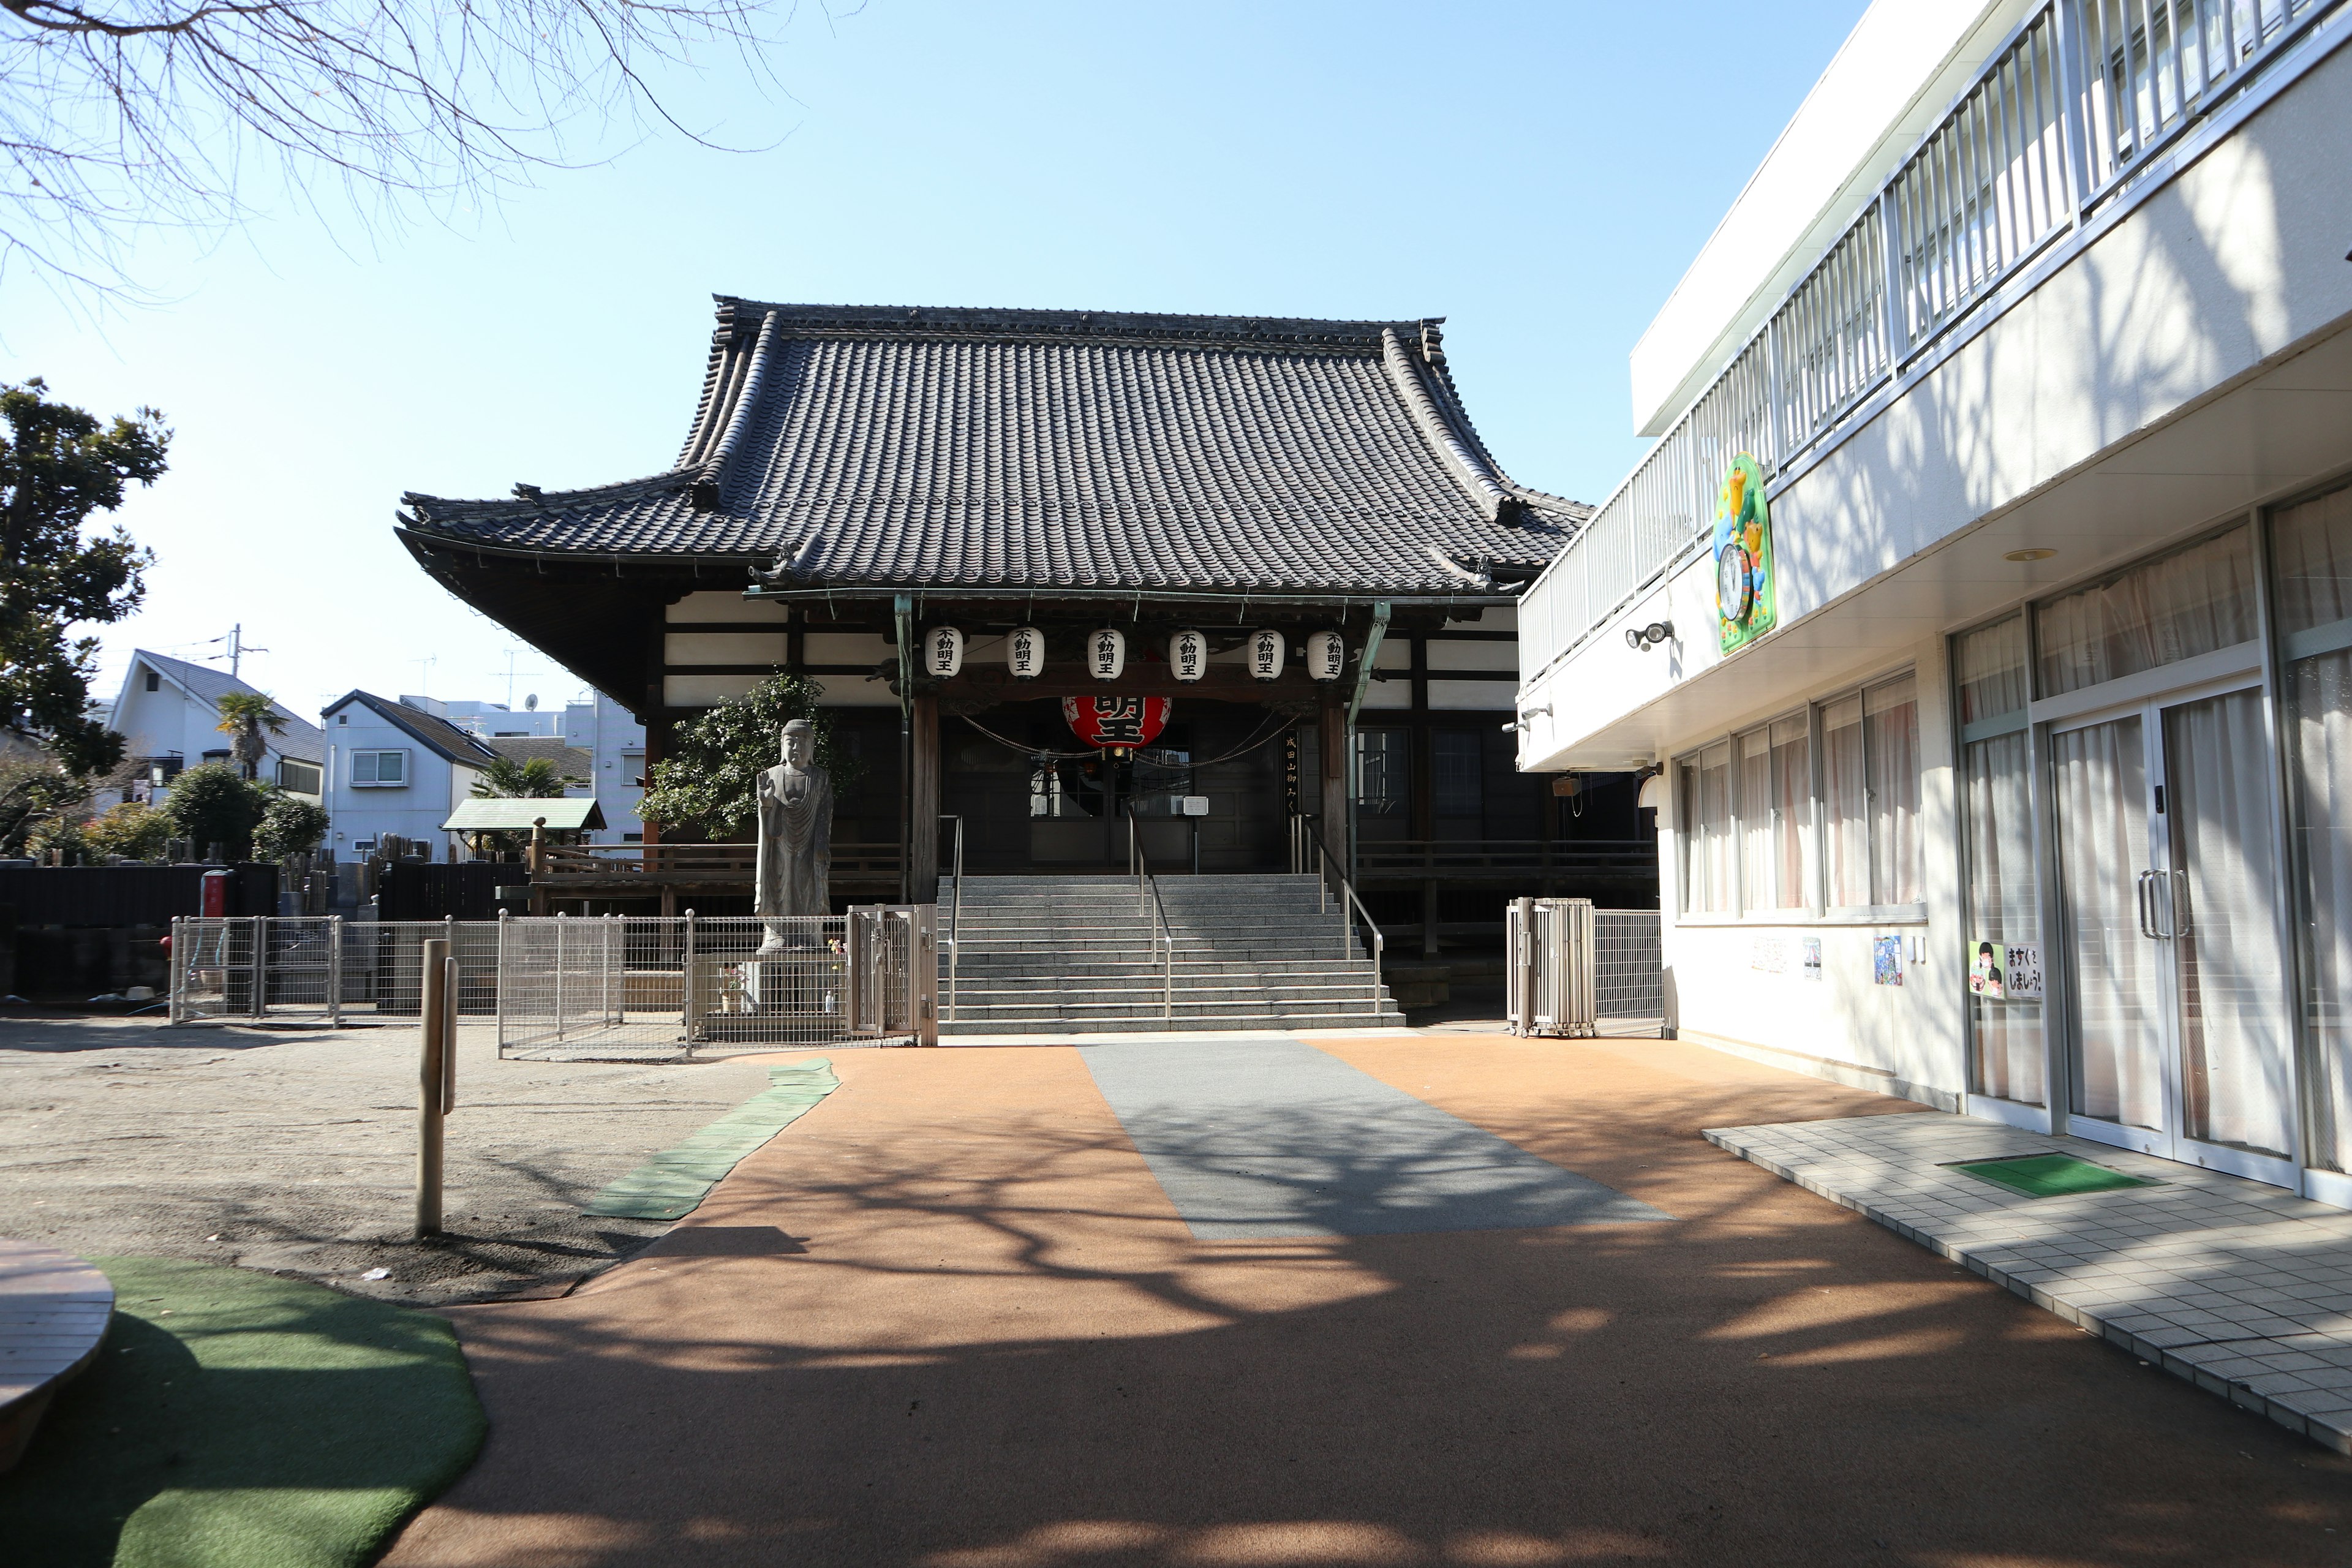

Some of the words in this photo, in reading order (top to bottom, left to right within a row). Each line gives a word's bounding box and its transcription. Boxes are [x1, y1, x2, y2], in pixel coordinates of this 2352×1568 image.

[935, 629, 954, 671] 不動明王
[1014, 629, 1031, 671] 不動明王
[1097, 631, 1115, 674] 不動明王
[1180, 633, 1197, 676] 不動明王
[1257, 632, 1275, 674] 不動明王
[1324, 634, 1341, 675] 不動明王
